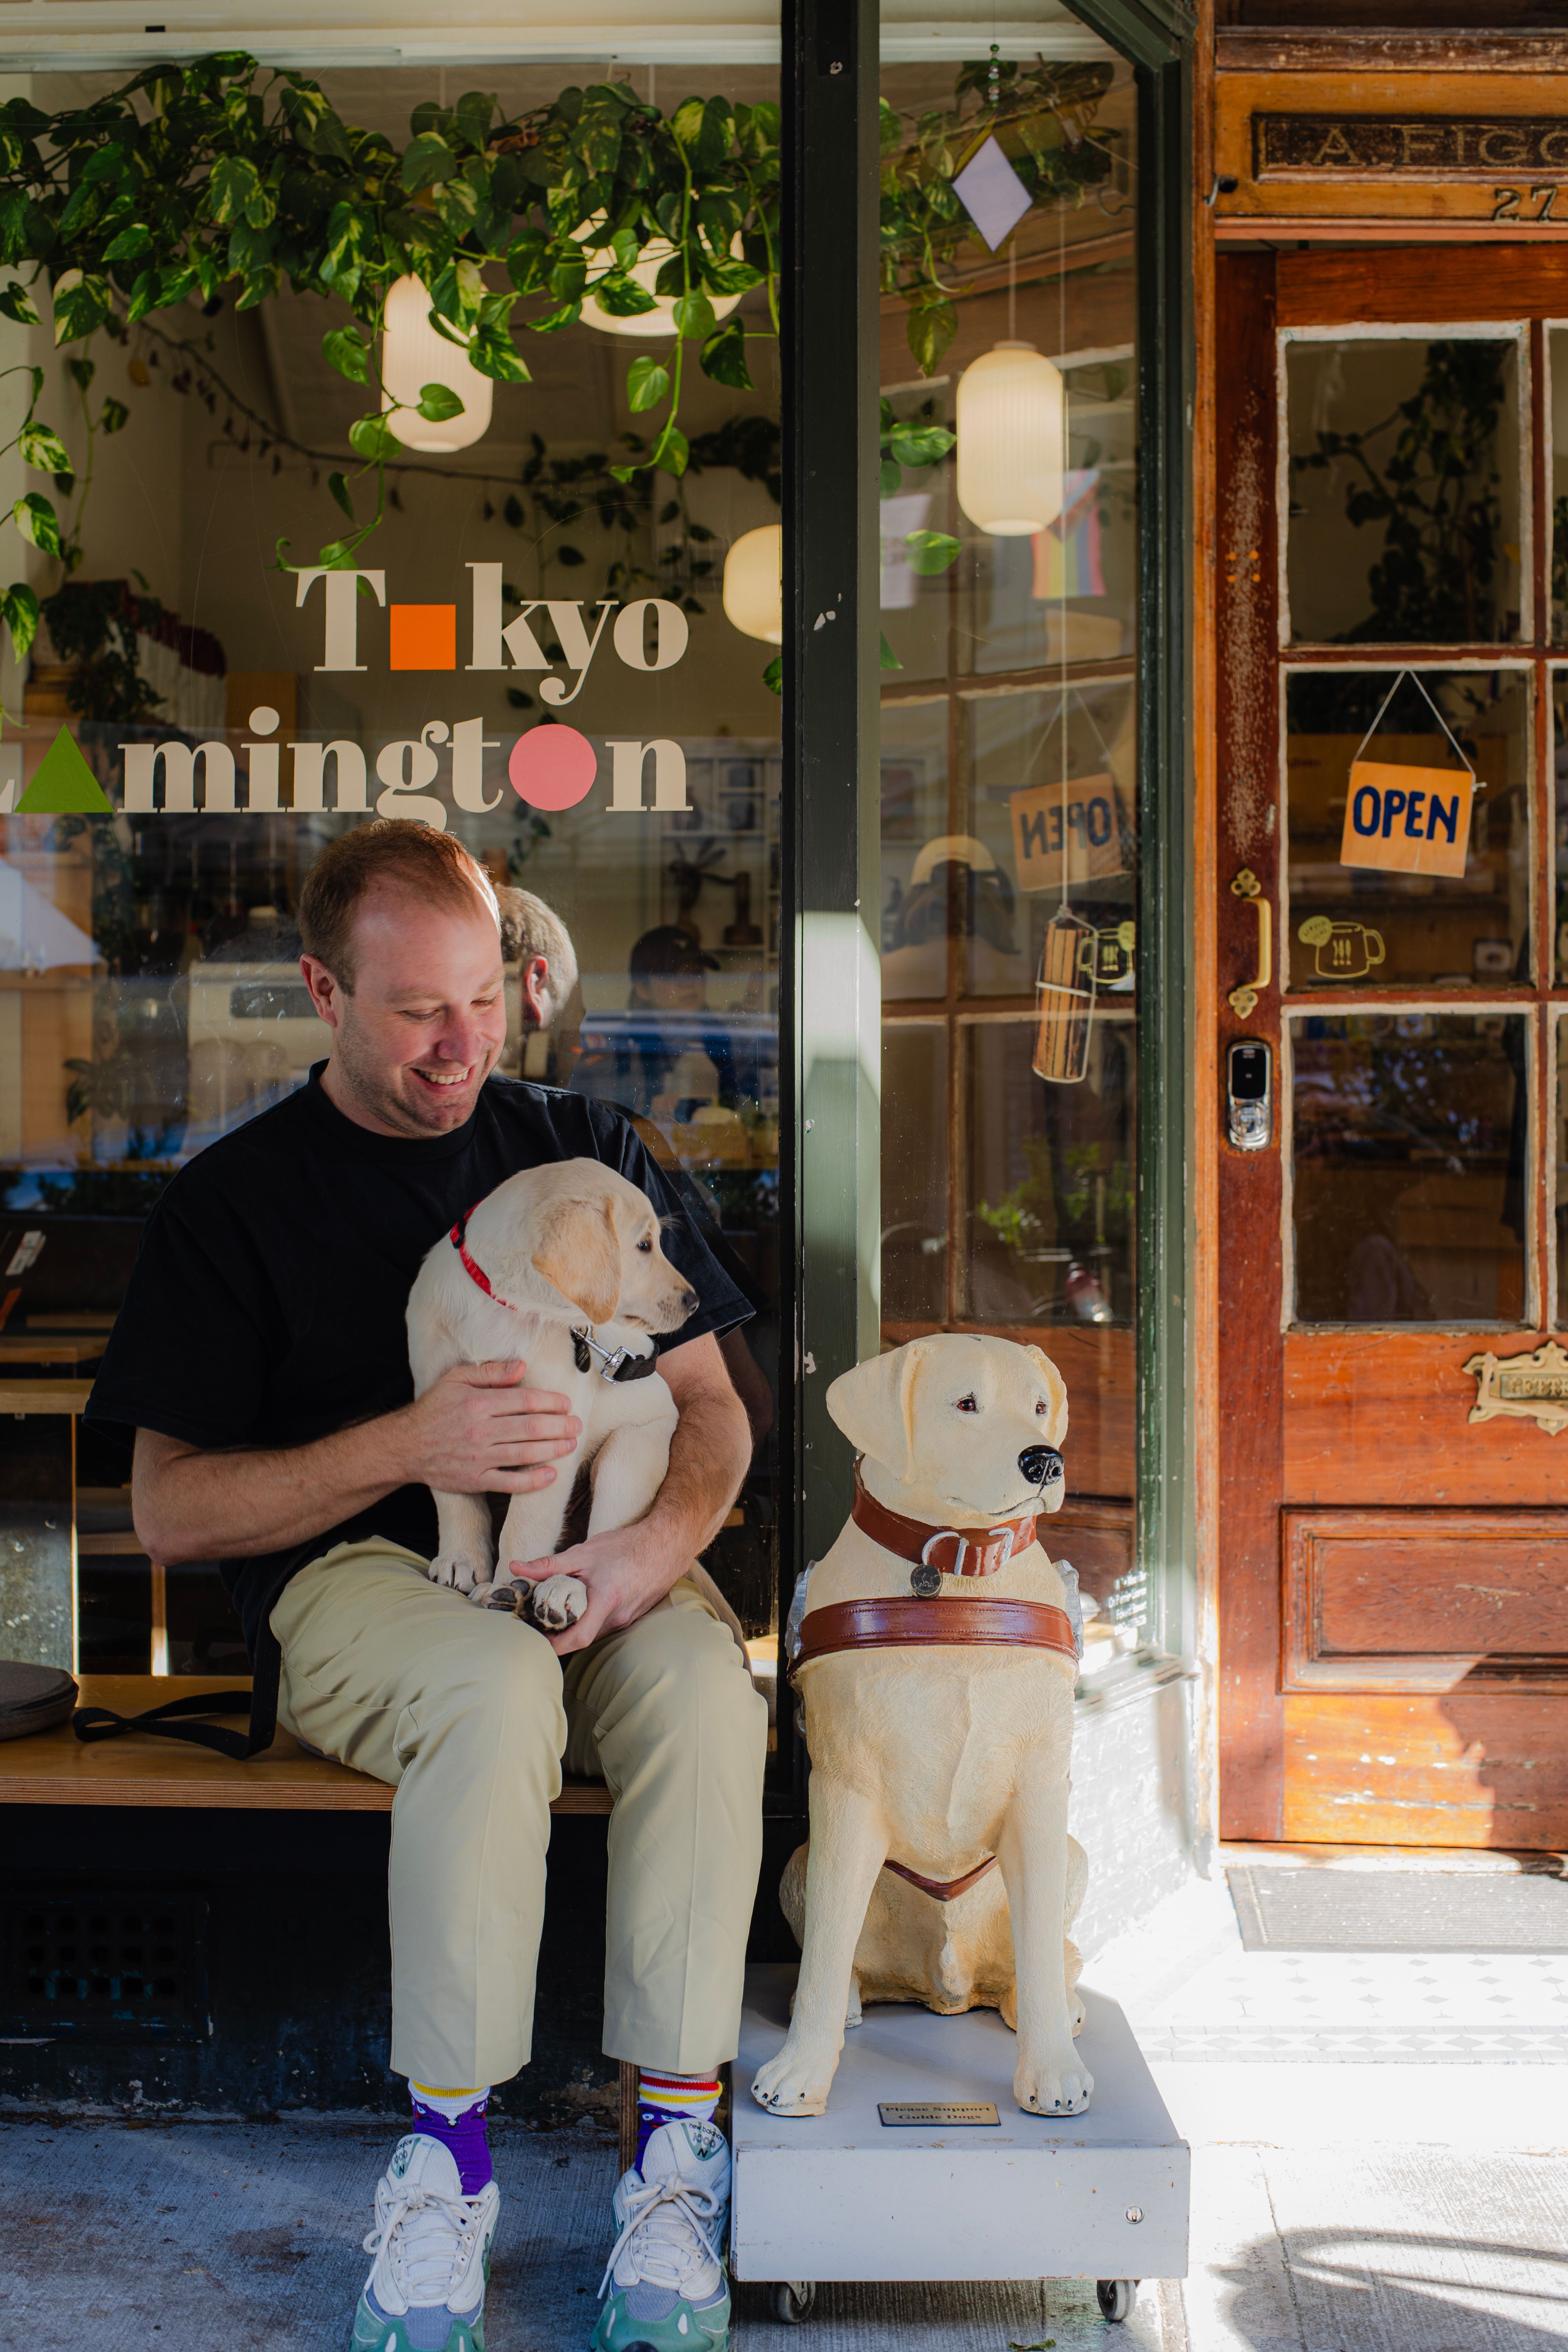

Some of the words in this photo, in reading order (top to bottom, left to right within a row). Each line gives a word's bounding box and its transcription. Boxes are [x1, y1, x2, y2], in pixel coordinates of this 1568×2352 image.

[296, 563, 689, 706] Tkyo
[1353, 785, 1459, 844] OPEN
[693, 2132, 716, 2148] 1000
[702, 2125, 723, 2141] balance
